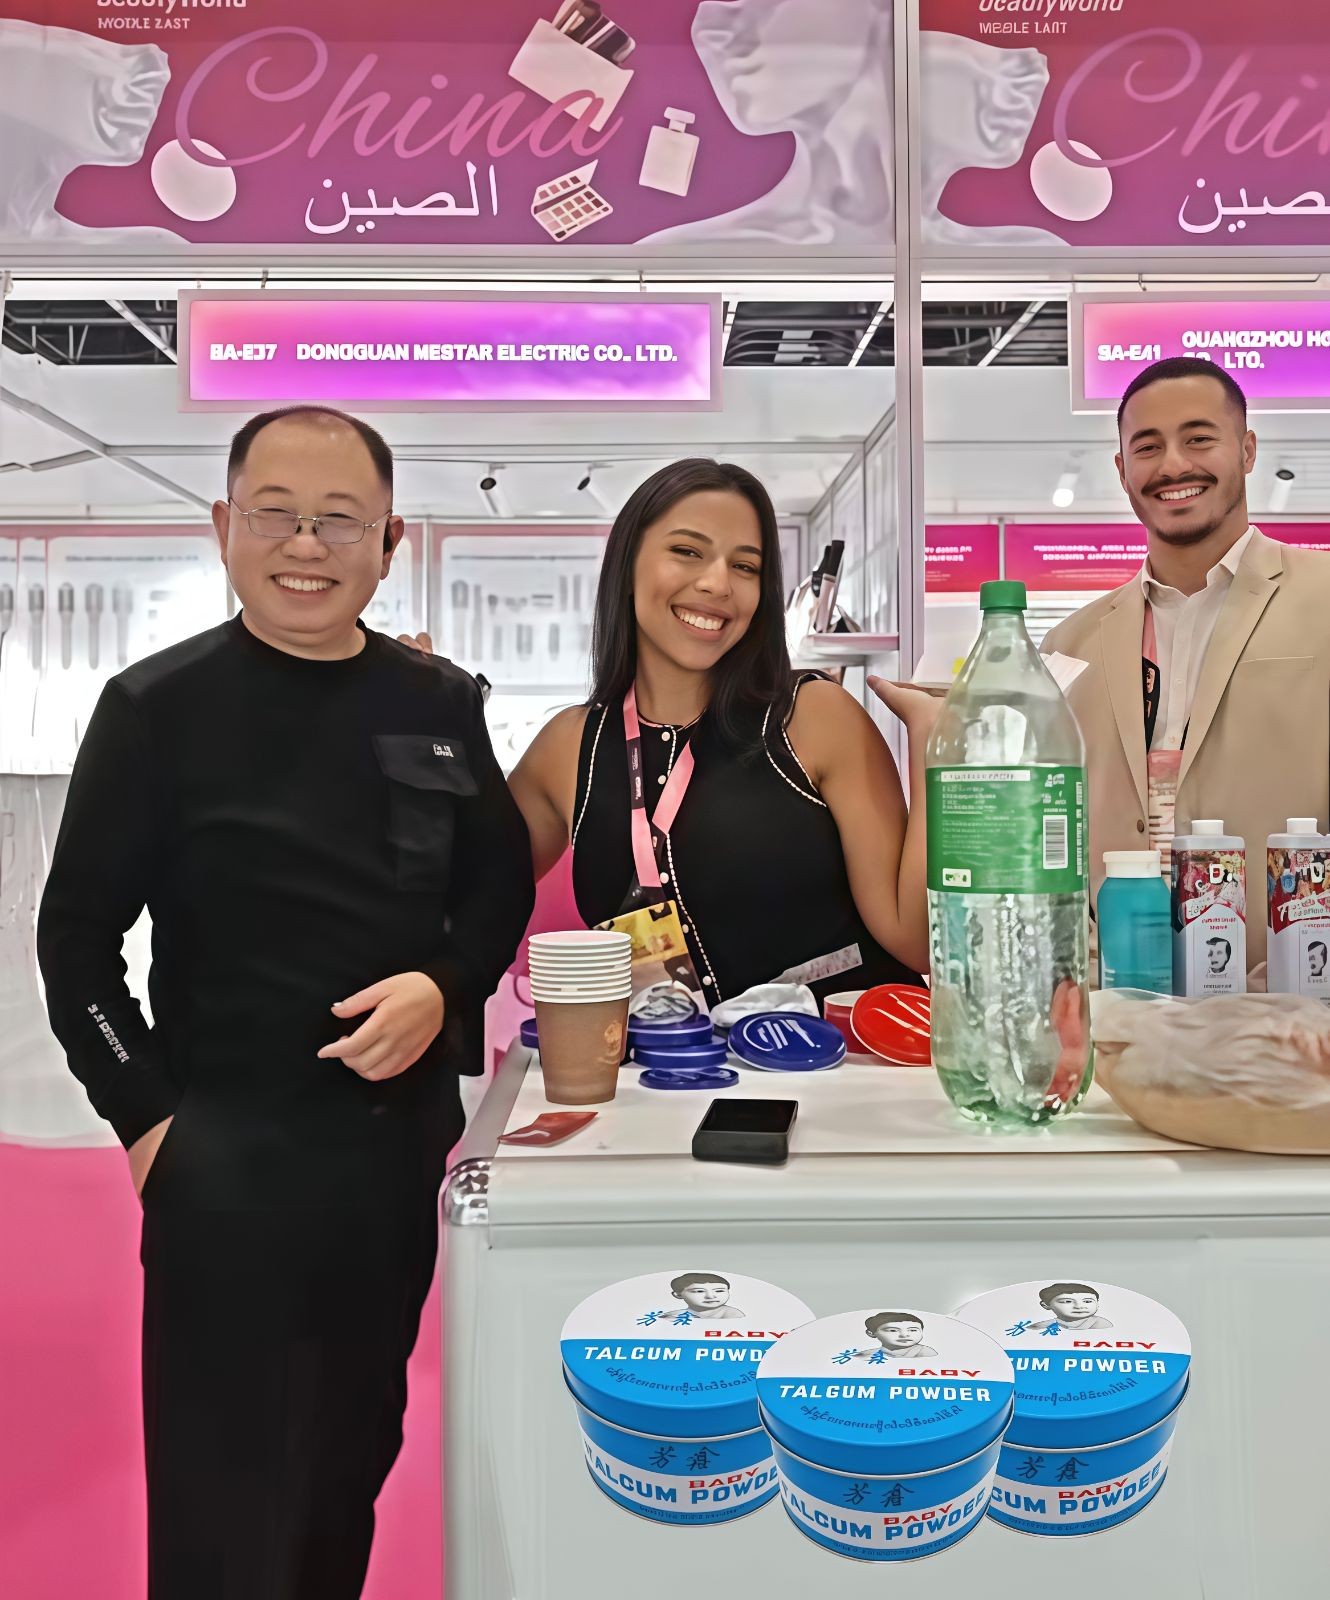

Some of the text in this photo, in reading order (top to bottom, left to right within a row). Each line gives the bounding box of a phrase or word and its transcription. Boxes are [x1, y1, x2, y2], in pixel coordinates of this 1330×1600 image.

[175, 26, 623, 167] China
[1053, 27, 1330, 168] Chi
[304, 161, 499, 234] الصين
[413, 344, 493, 361] MESTAR
[497, 344, 590, 361] ELECTRIC
[636, 344, 678, 362] LTD.
[584, 1346, 681, 1361] TALCUM
[1064, 1358, 1166, 1374] POWDER
[889, 1386, 991, 1402] POWDER
